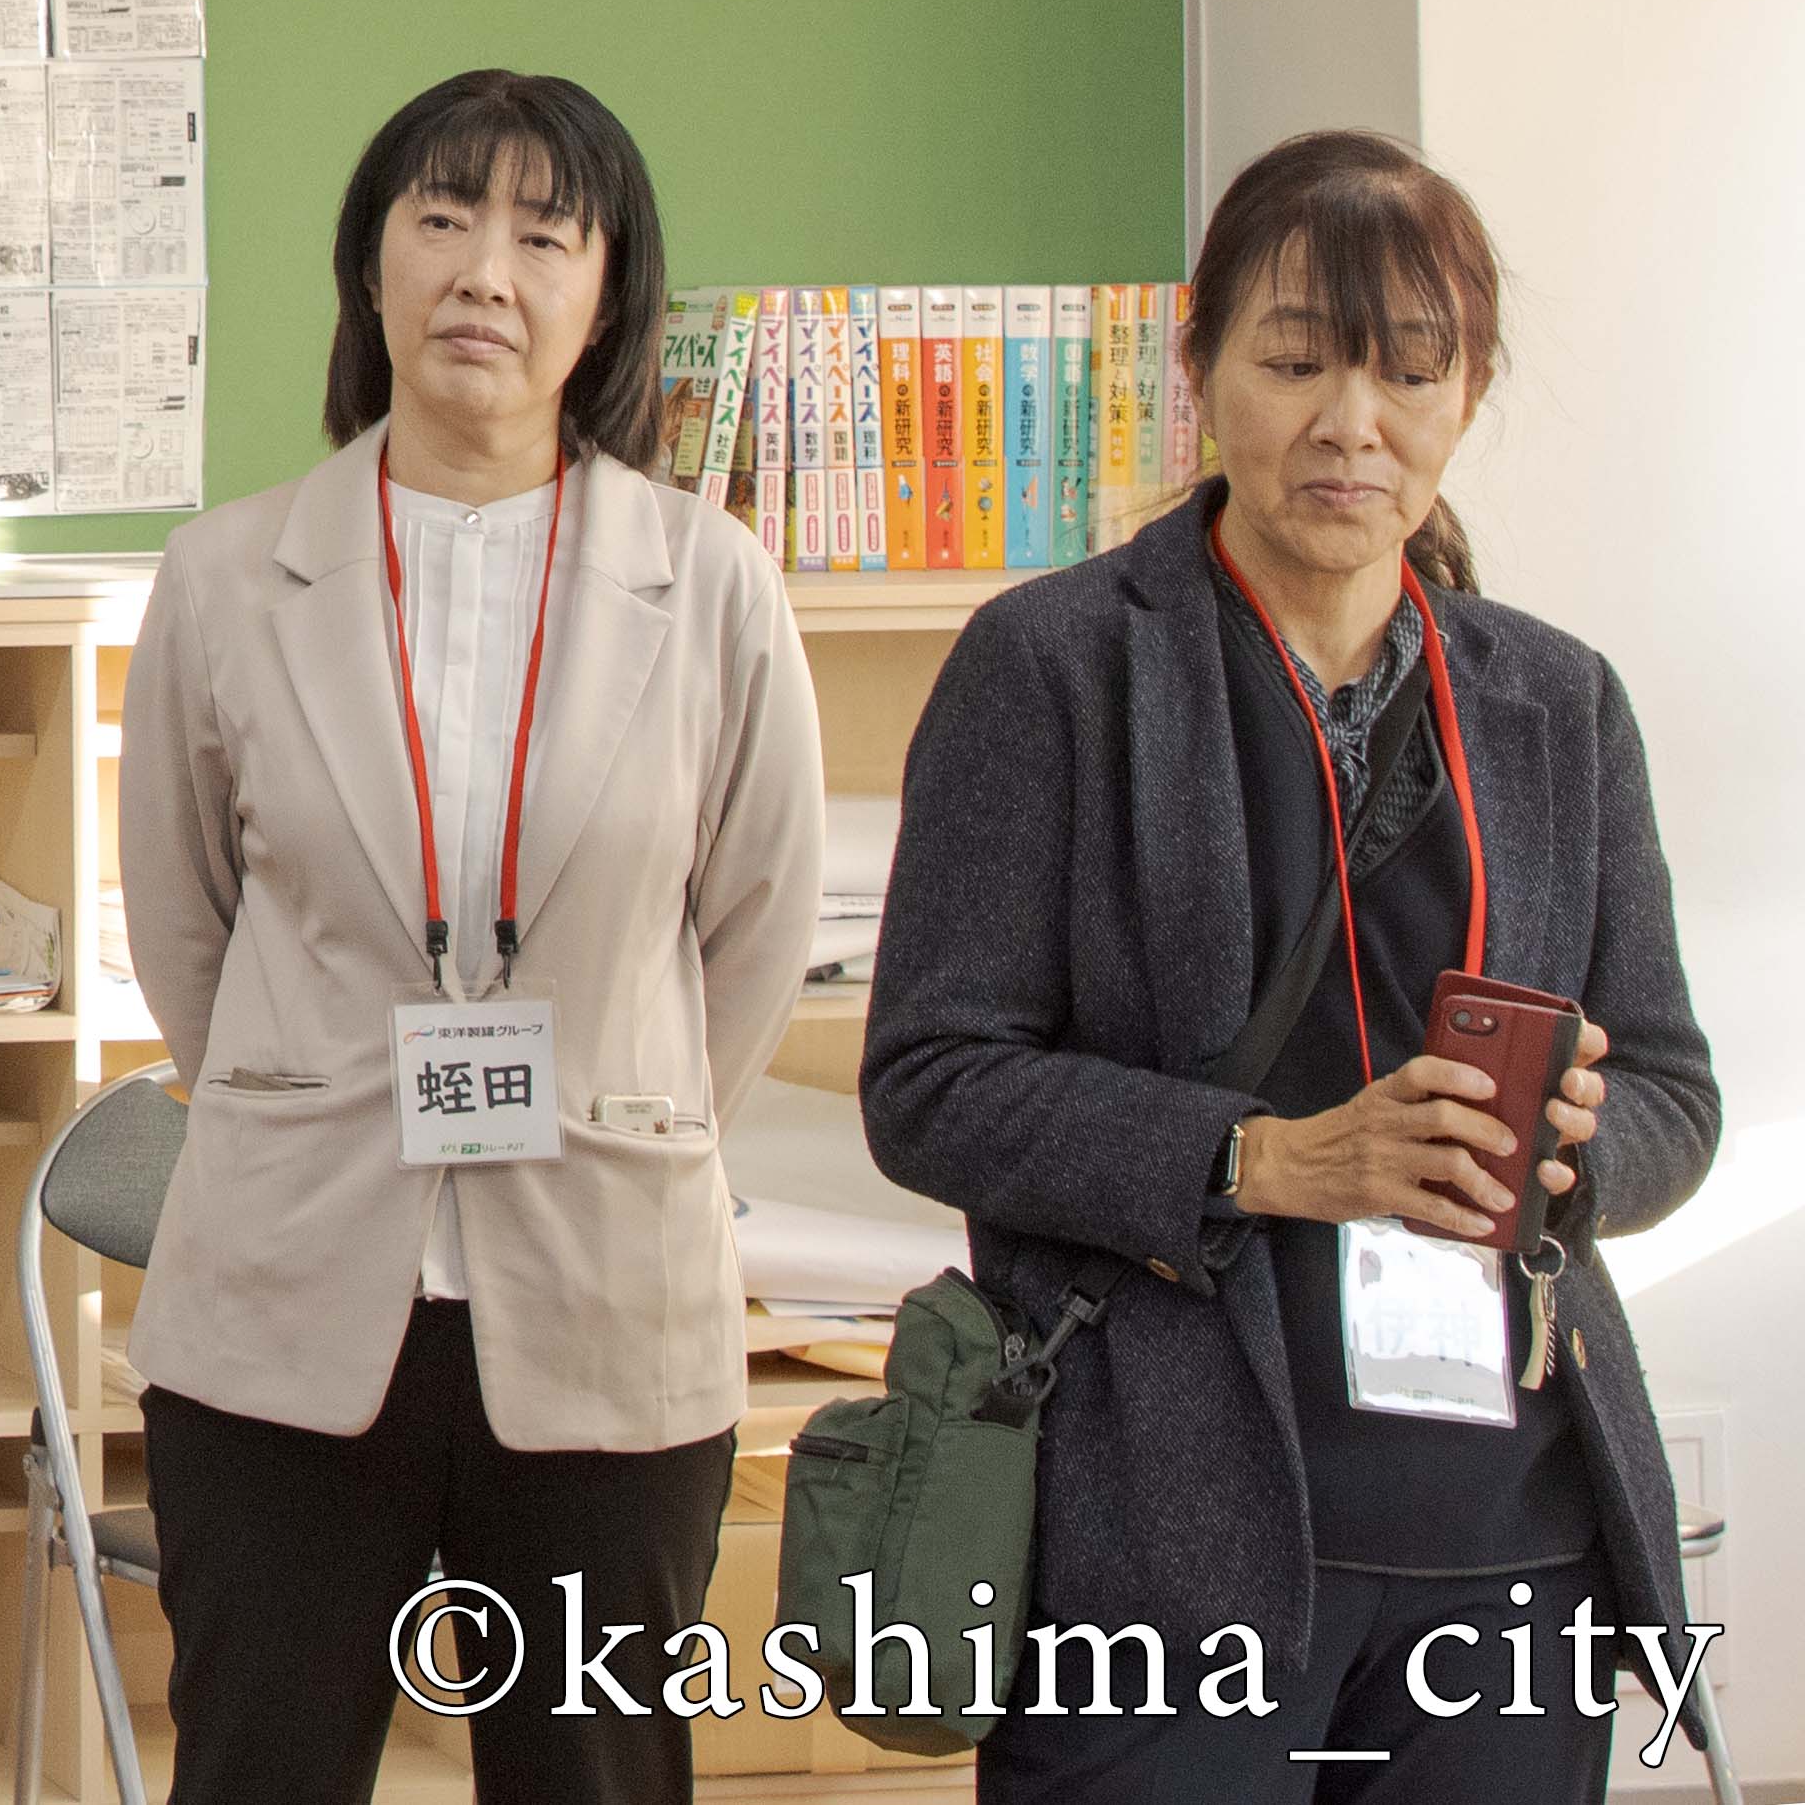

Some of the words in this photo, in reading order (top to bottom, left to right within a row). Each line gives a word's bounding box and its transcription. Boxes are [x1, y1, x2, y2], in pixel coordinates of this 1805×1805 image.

[717, 320, 754, 427] マイペース
[760, 319, 785, 425] マイペース
[797, 319, 826, 424] マイペース
[826, 319, 851, 423] マイペース
[853, 319, 879, 423] マイペース
[891, 342, 913, 455] 理科の新研究
[933, 342, 953, 456] 英語の新研究
[975, 342, 994, 456] 社会の新研究
[1019, 342, 1038, 456] 数学の新研究
[1109, 323, 1130, 423] 整理と対策
[1137, 322, 1158, 423] 整理と対策
[714, 433, 730, 463] 社会
[765, 431, 779, 462] 英語
[804, 432, 819, 461] 数学
[833, 431, 848, 461] 国語
[863, 430, 878, 460] 理科
[438, 1024, 543, 1039] 東洋製罐グループ
[417, 1061, 532, 1114] 蛭田
